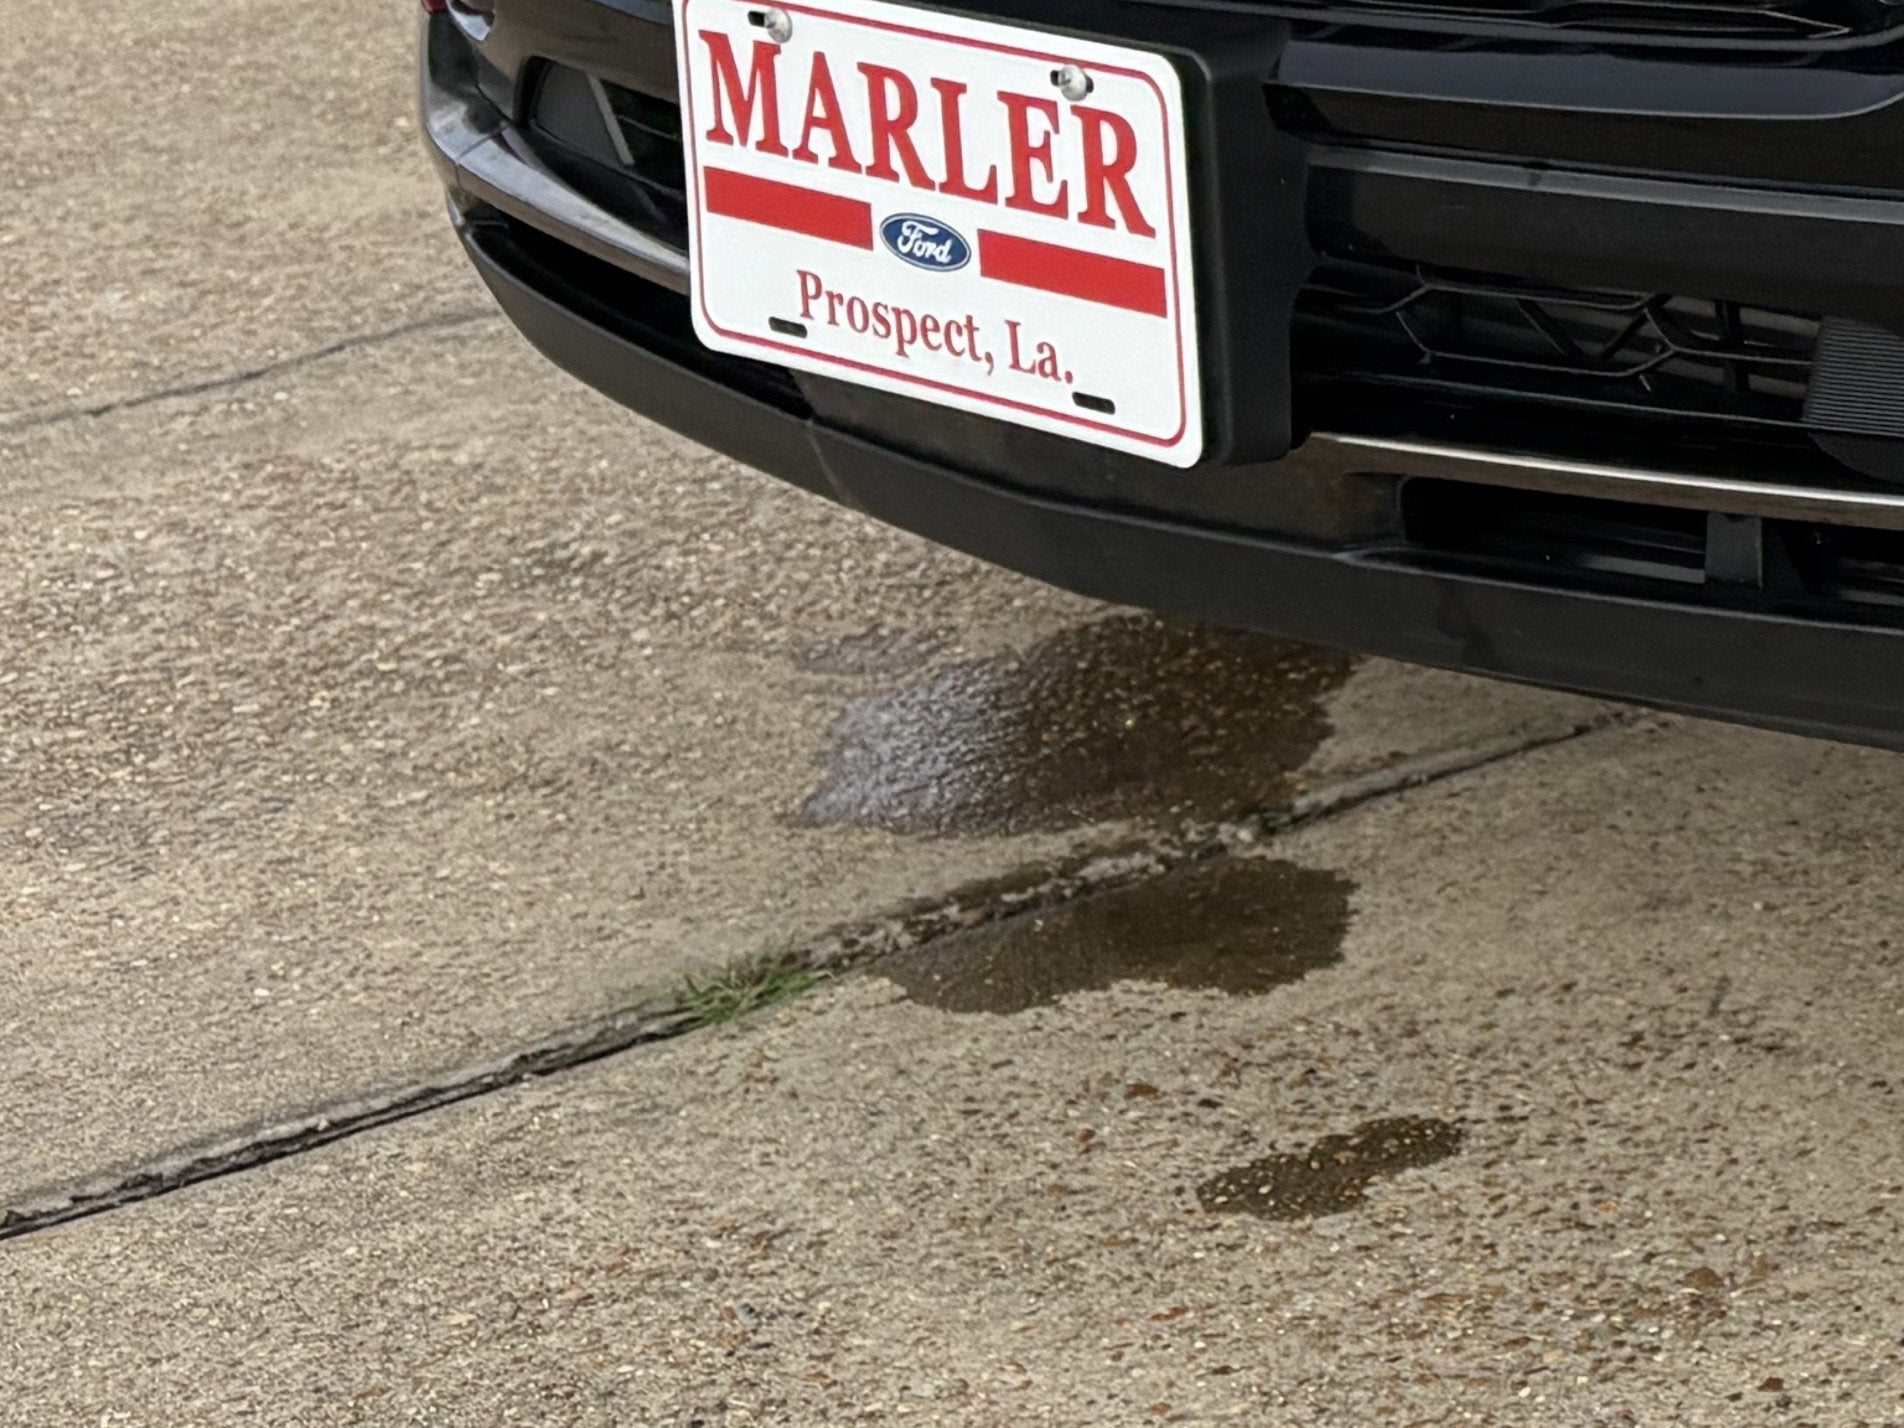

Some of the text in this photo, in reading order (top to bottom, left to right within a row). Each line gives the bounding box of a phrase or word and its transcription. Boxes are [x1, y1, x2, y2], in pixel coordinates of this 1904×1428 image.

[698, 29, 1157, 239] MARLER
[896, 220, 953, 264] Ford
[796, 269, 1074, 384] Prospect, La.
